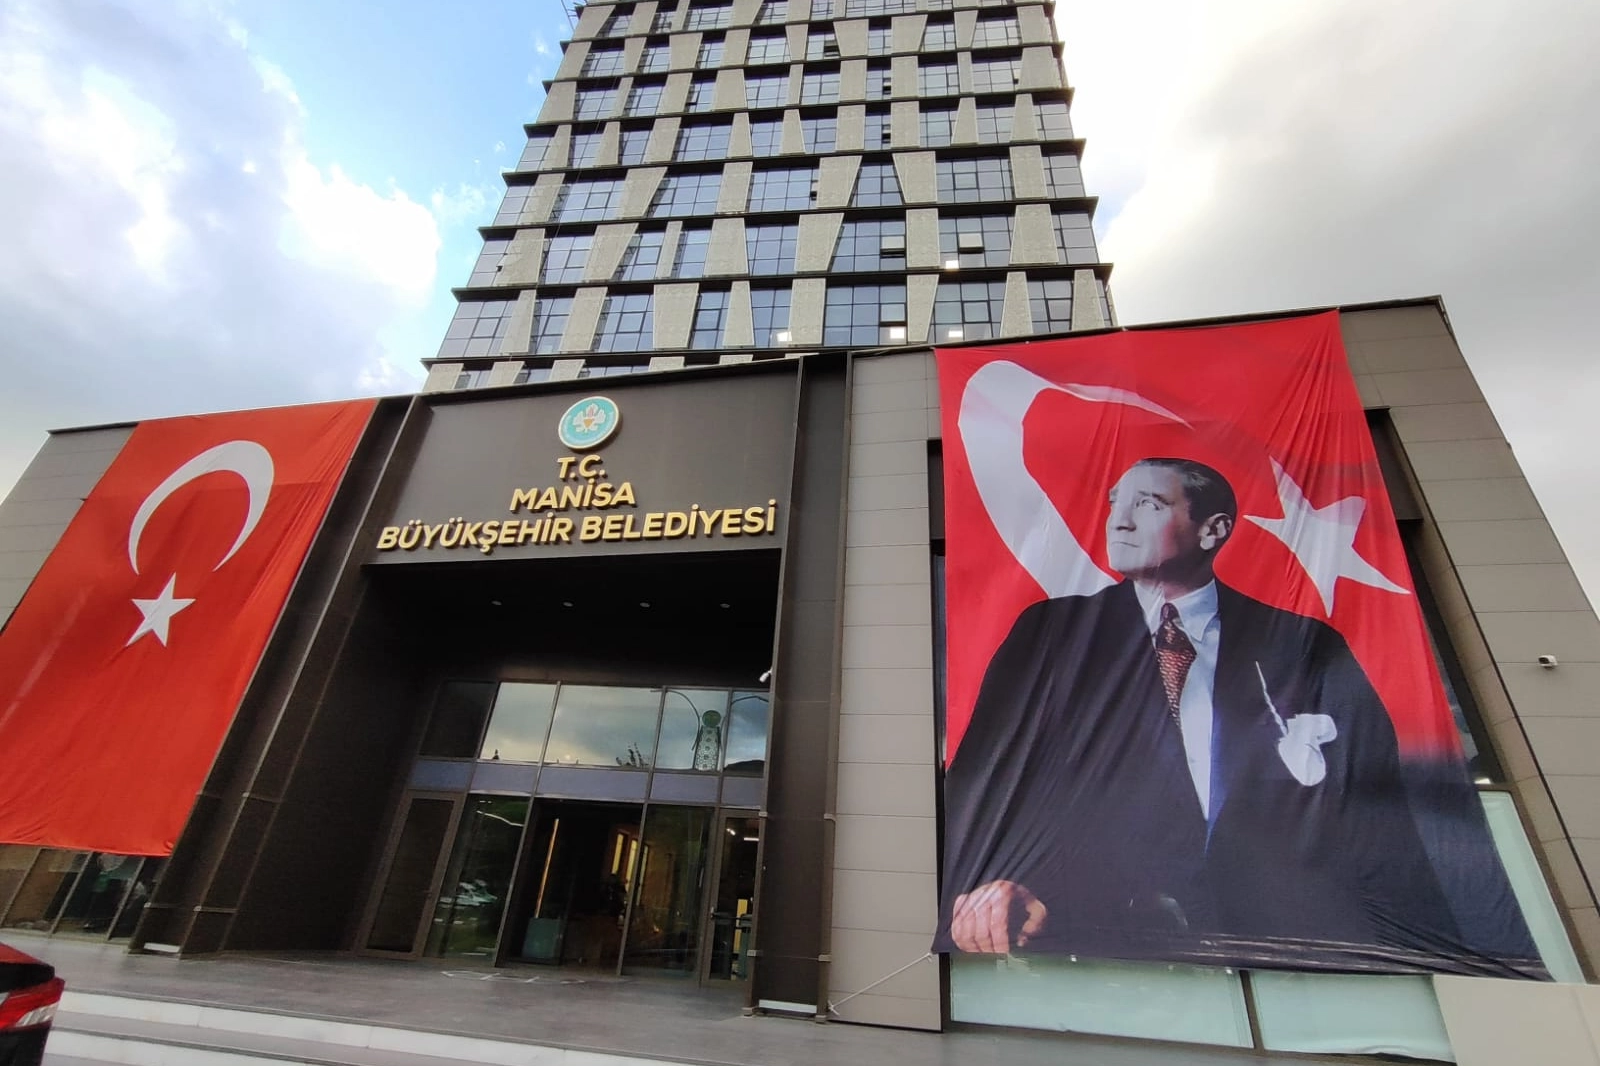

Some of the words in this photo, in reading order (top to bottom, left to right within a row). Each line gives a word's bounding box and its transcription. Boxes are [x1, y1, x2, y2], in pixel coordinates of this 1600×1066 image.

[557, 455, 606, 479] T.C.
[509, 479, 636, 511] MANİSA
[376, 513, 571, 552] BÜYÜKŞEHİR
[580, 499, 776, 542] BELEDİYESİ
